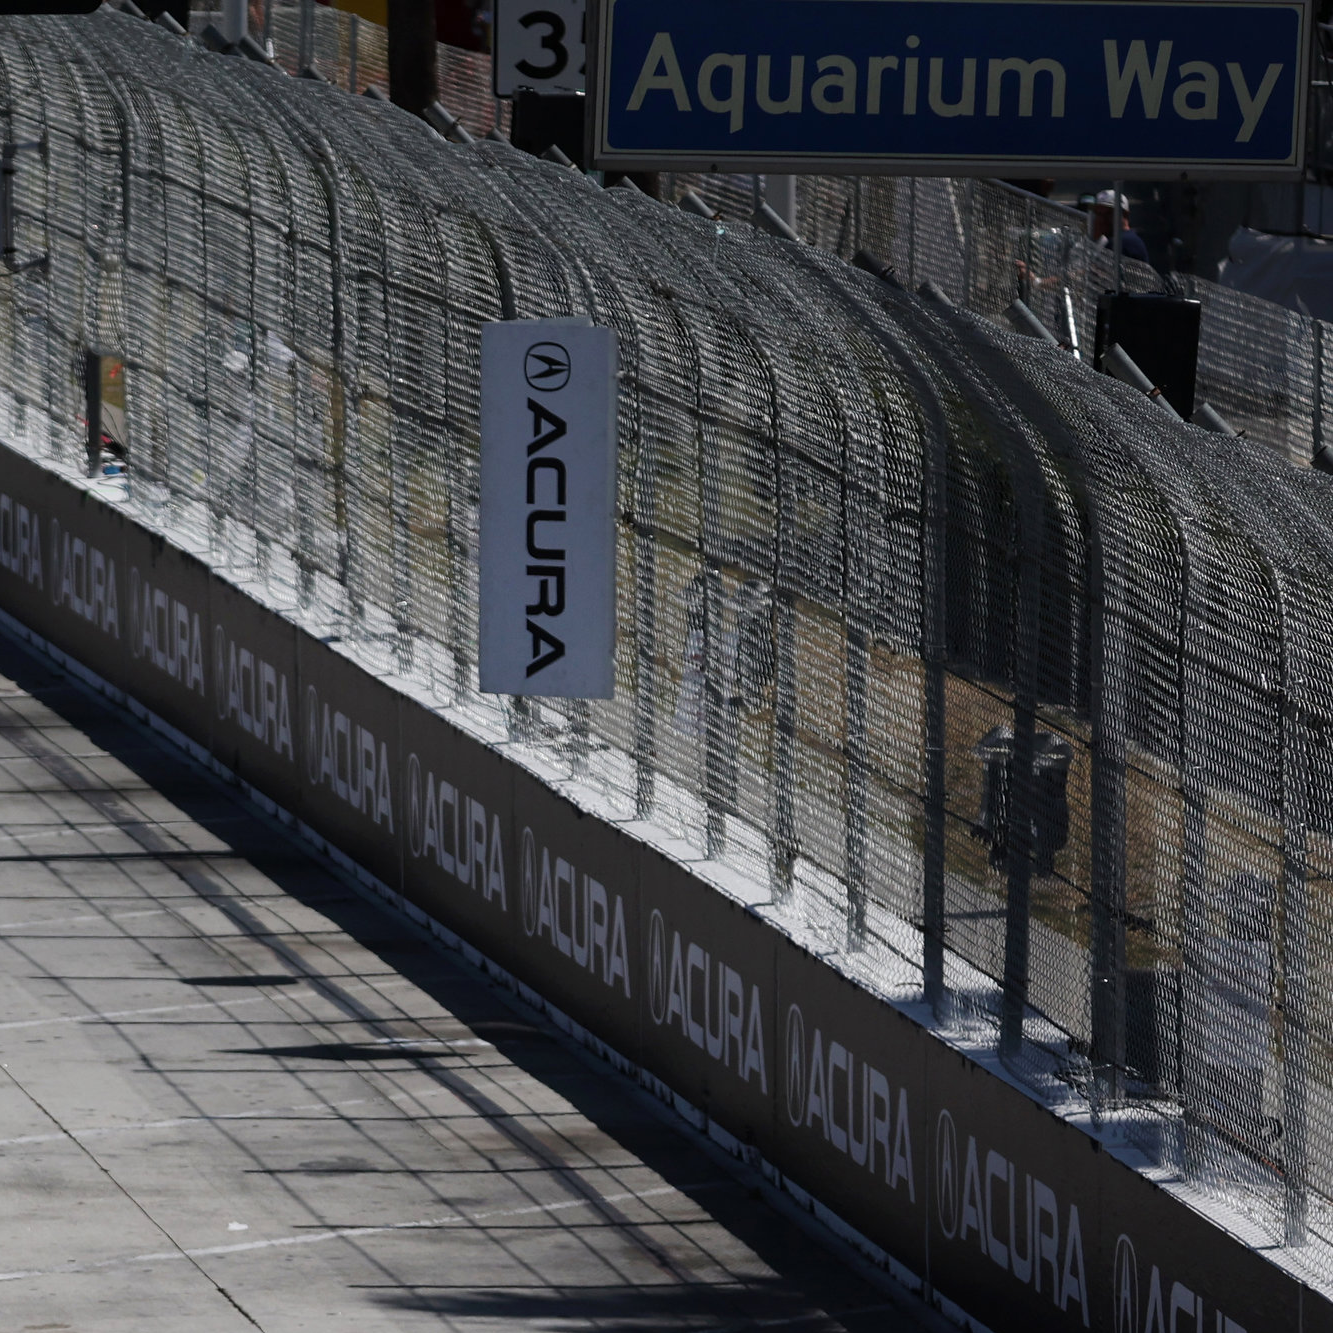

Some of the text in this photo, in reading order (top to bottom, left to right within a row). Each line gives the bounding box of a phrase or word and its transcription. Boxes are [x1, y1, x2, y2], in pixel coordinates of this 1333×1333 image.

[516, 11, 585, 79] 3
[626, 33, 1283, 143] Aquarium Way
[59, 531, 118, 639] ACURA
[525, 397, 568, 679] ACURA
[137, 581, 204, 697] ACURA
[226, 640, 293, 761] ACURA
[321, 703, 395, 835] ACURA
[424, 771, 507, 912] ACURA
[538, 846, 631, 999] ACURA
[666, 930, 767, 1096] ACURA
[807, 1027, 915, 1204] ACURA
[959, 1135, 1090, 1328] ACURA
